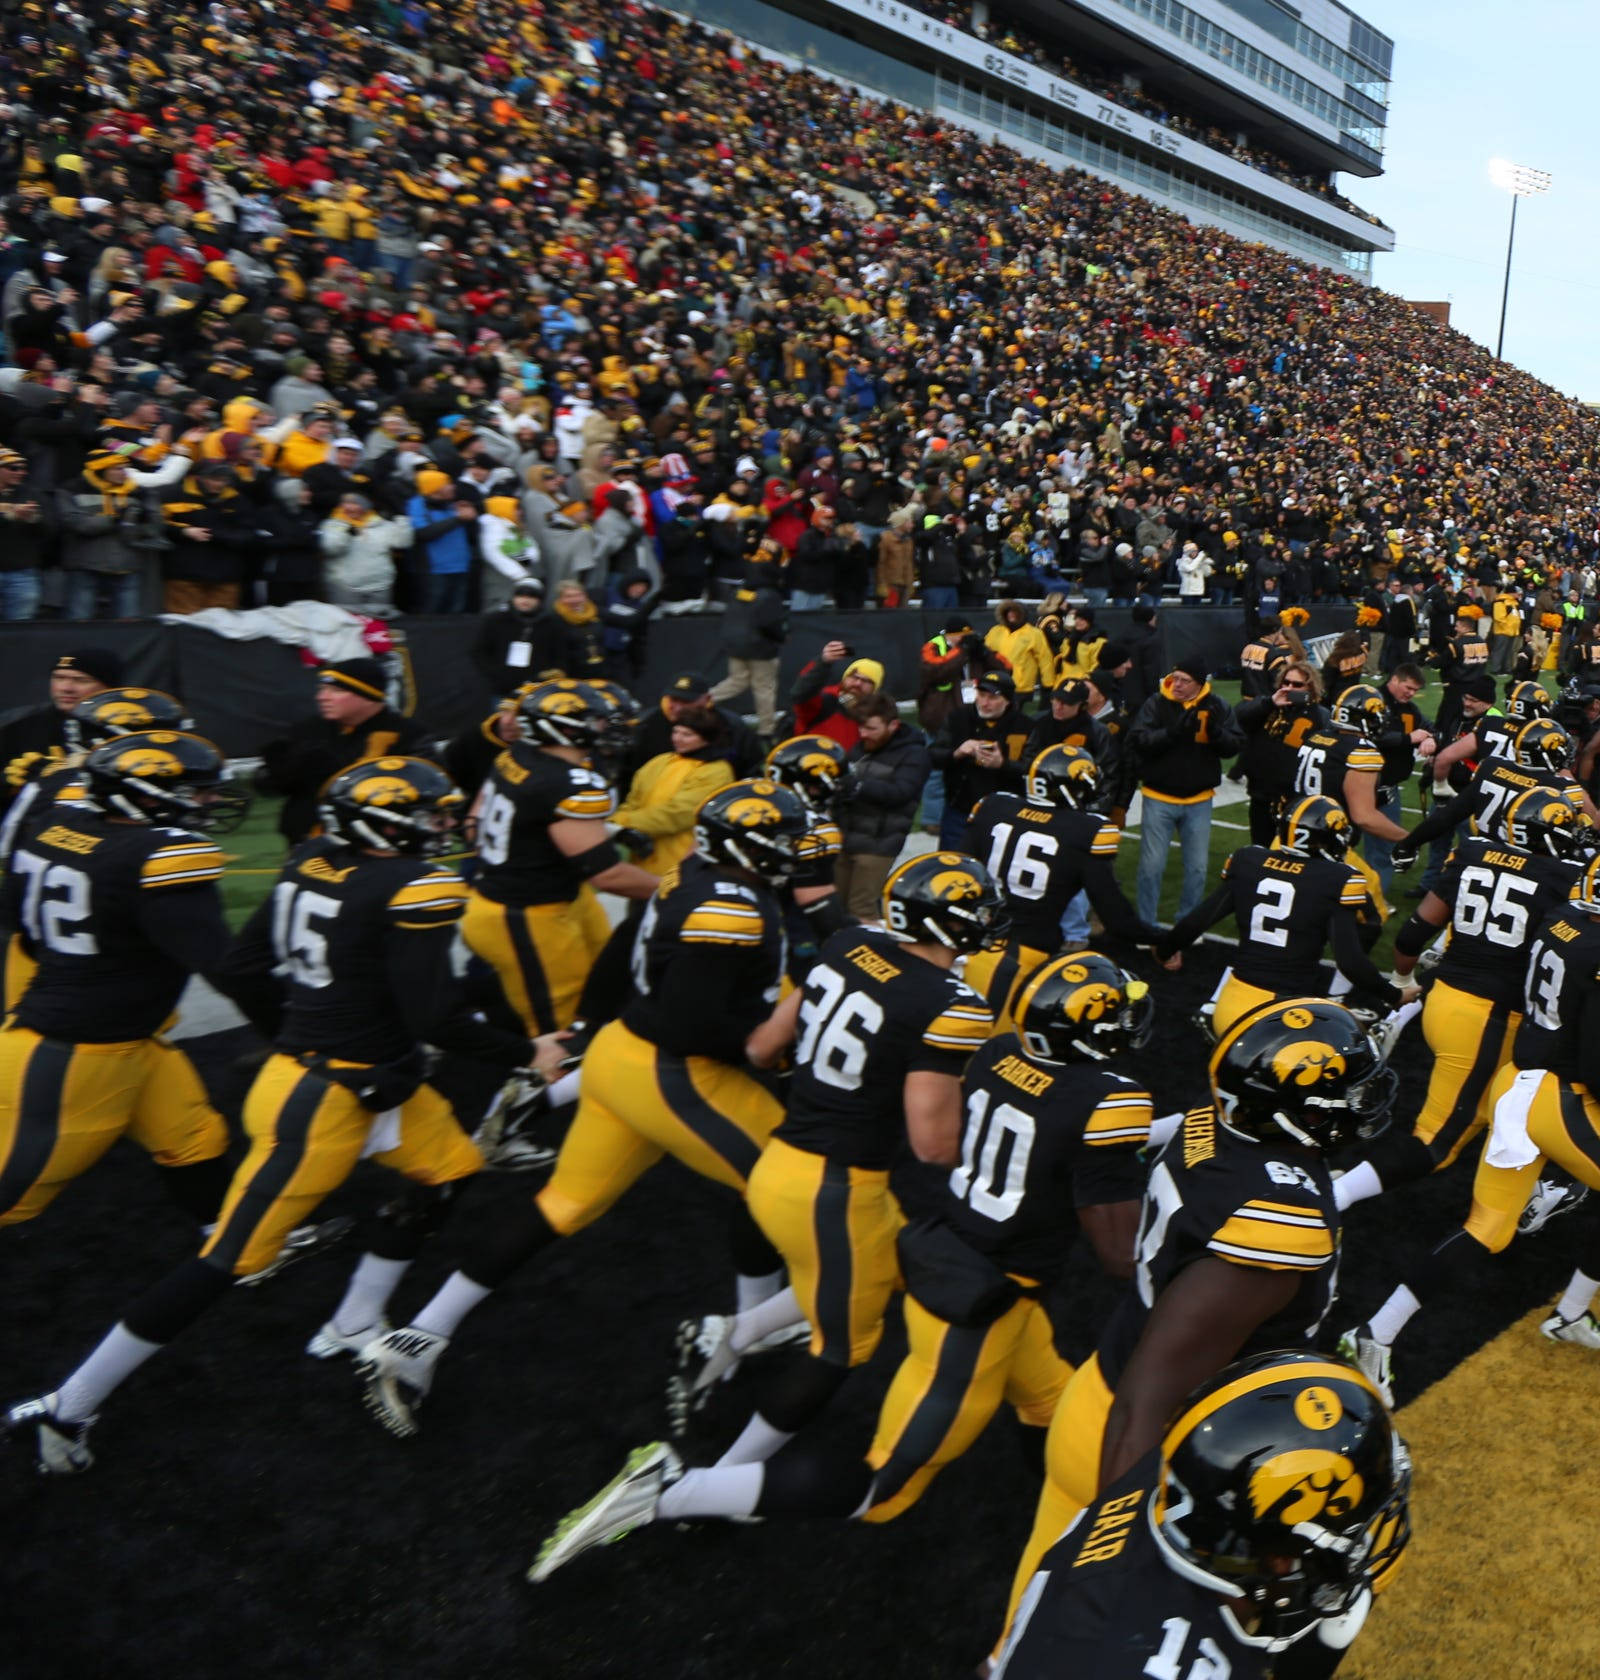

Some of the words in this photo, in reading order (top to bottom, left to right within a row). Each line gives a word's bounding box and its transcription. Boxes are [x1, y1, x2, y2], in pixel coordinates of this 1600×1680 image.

[984, 54, 1005, 76] 62
[1097, 104, 1114, 123] 77
[1294, 744, 1327, 796] 76
[1016, 806, 1054, 824] KIDD
[1293, 828, 1311, 850] 2
[986, 822, 1060, 901] 16
[1262, 856, 1305, 875] ELLIS
[1481, 849, 1528, 871] WALSH
[12, 848, 101, 956] 72
[887, 900, 909, 930] 6
[1250, 877, 1297, 948] 2
[1454, 865, 1539, 949] 65
[270, 880, 344, 989] 15
[844, 944, 903, 985] FISHER
[1525, 938, 1567, 1032] 13
[795, 962, 885, 1092] 36
[990, 1053, 1055, 1098] PARKER
[948, 1088, 1037, 1223] 10
[1072, 1487, 1145, 1569] GAIR
